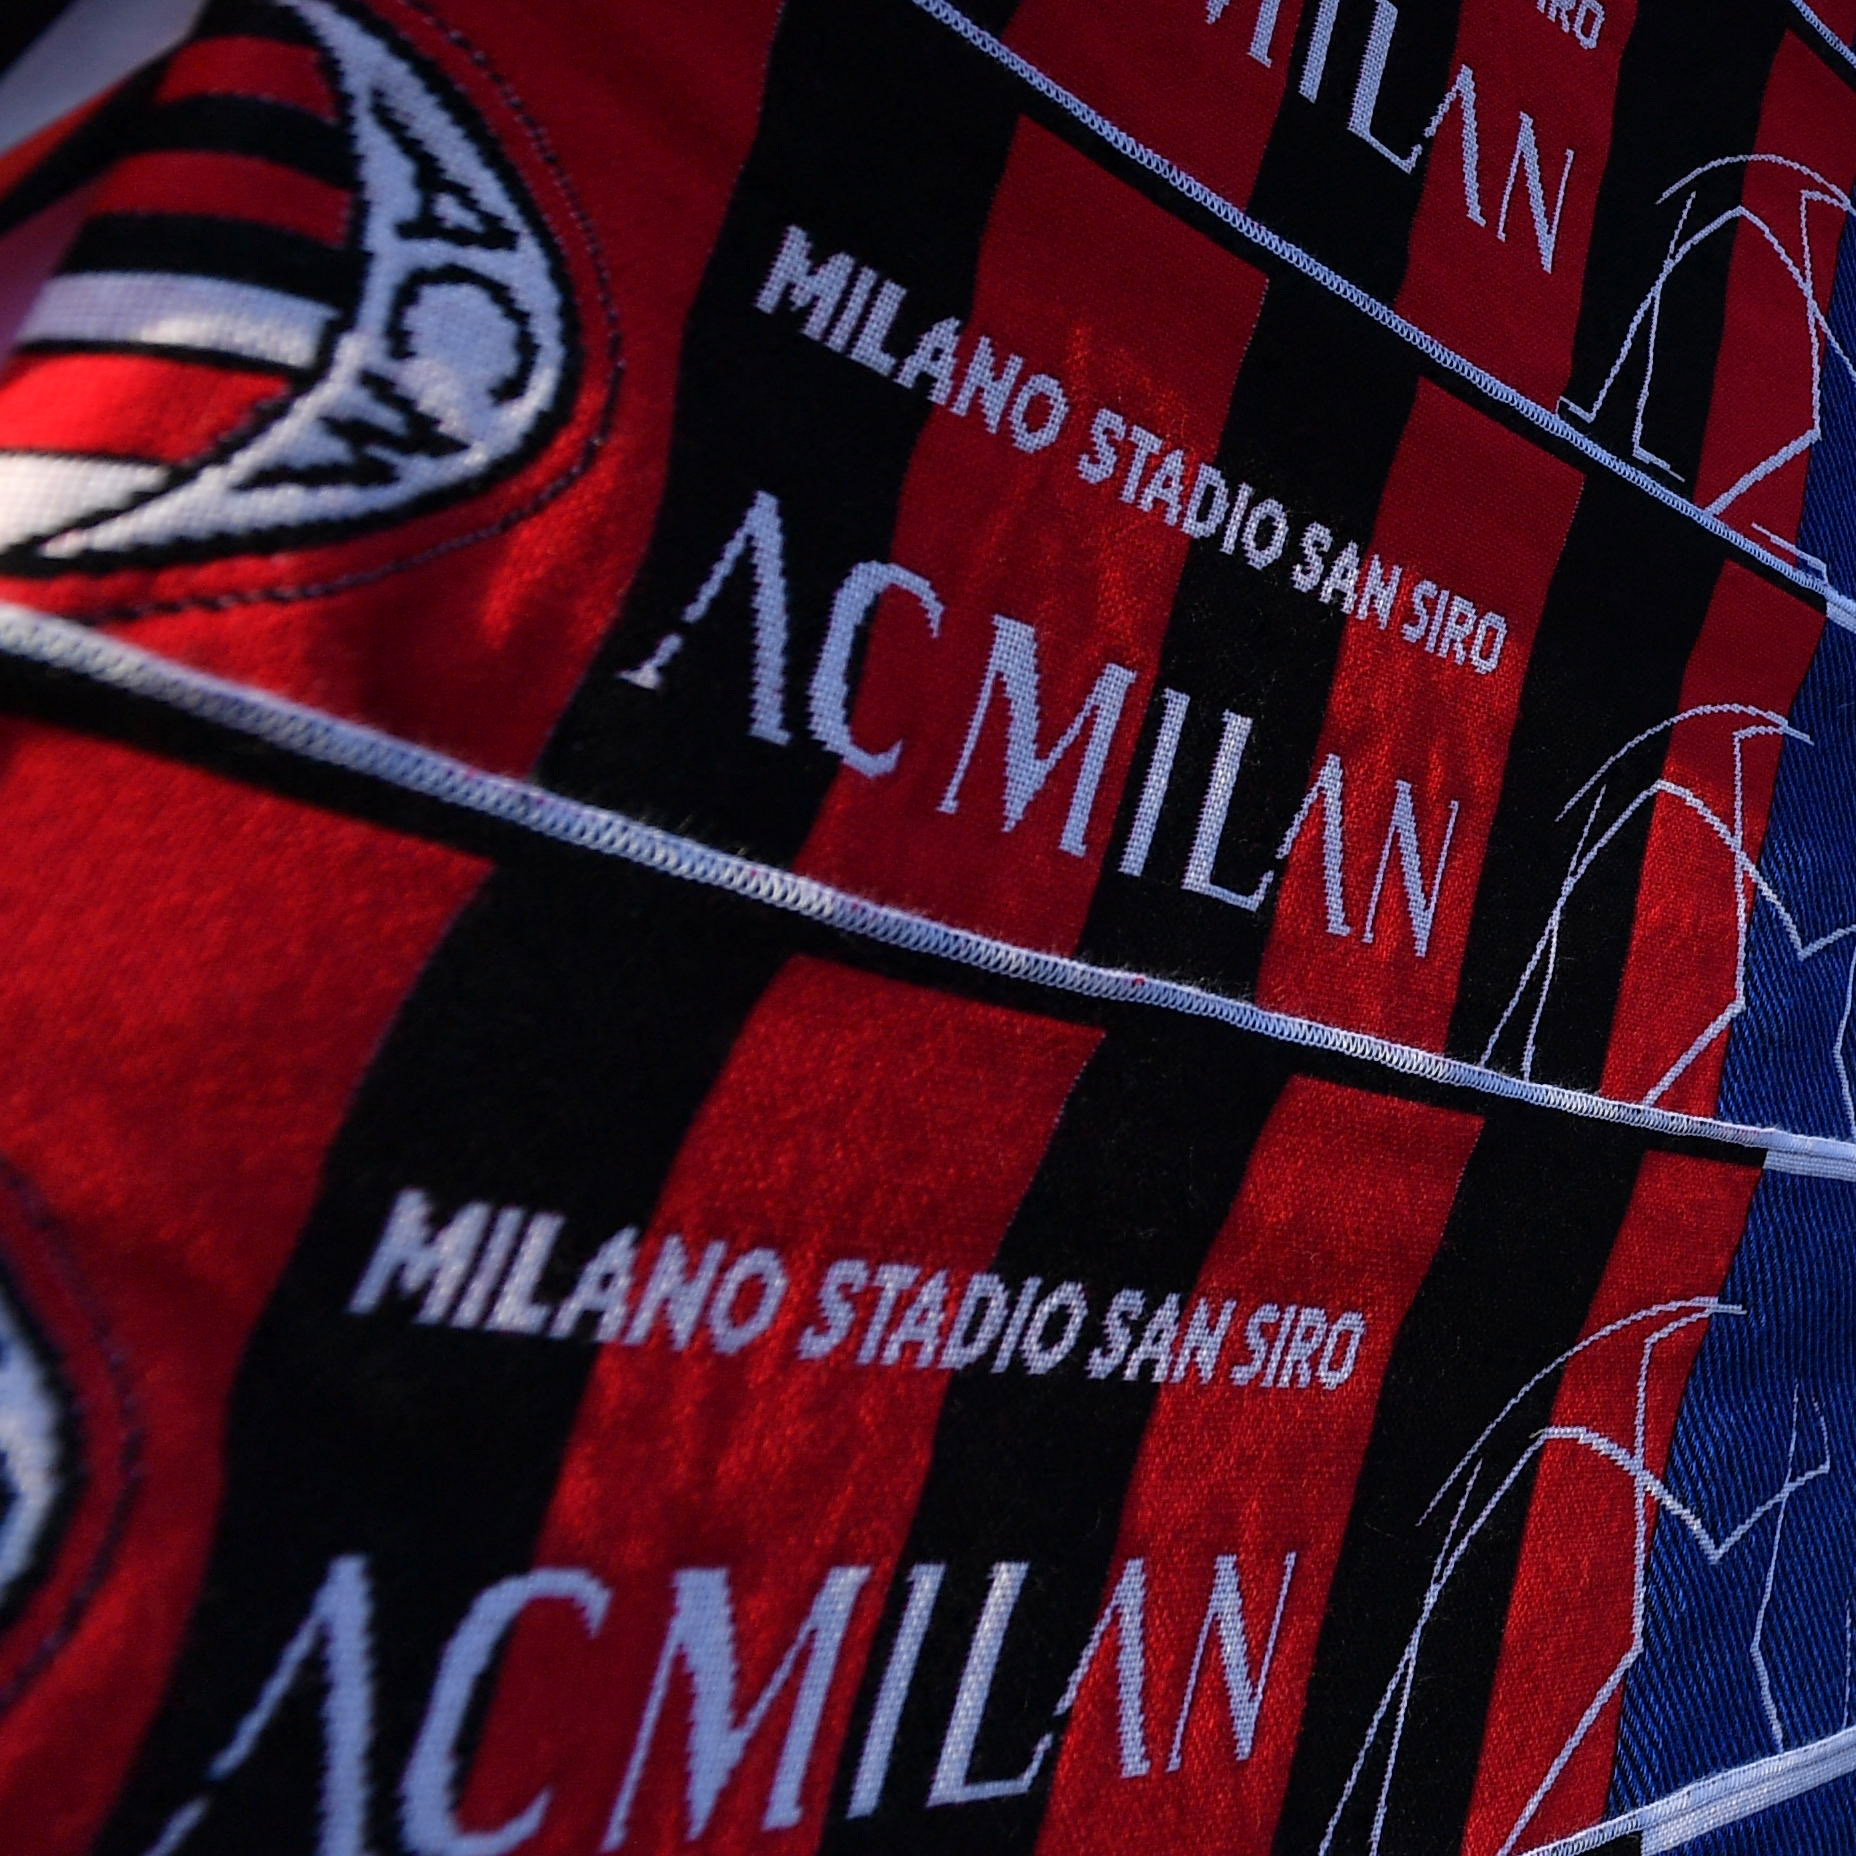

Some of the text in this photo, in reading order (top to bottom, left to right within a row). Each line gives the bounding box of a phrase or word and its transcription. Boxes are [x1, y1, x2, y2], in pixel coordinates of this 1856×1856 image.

[232, 88, 540, 490] ACM
[756, 226, 1507, 674] MILANO STADIO SAN SIRO
[621, 491, 1458, 957] AC MILAN
[354, 1191, 1365, 1390] MILANO STADIO SAN SIRO
[149, 1552, 1296, 1856] AC MILAN
